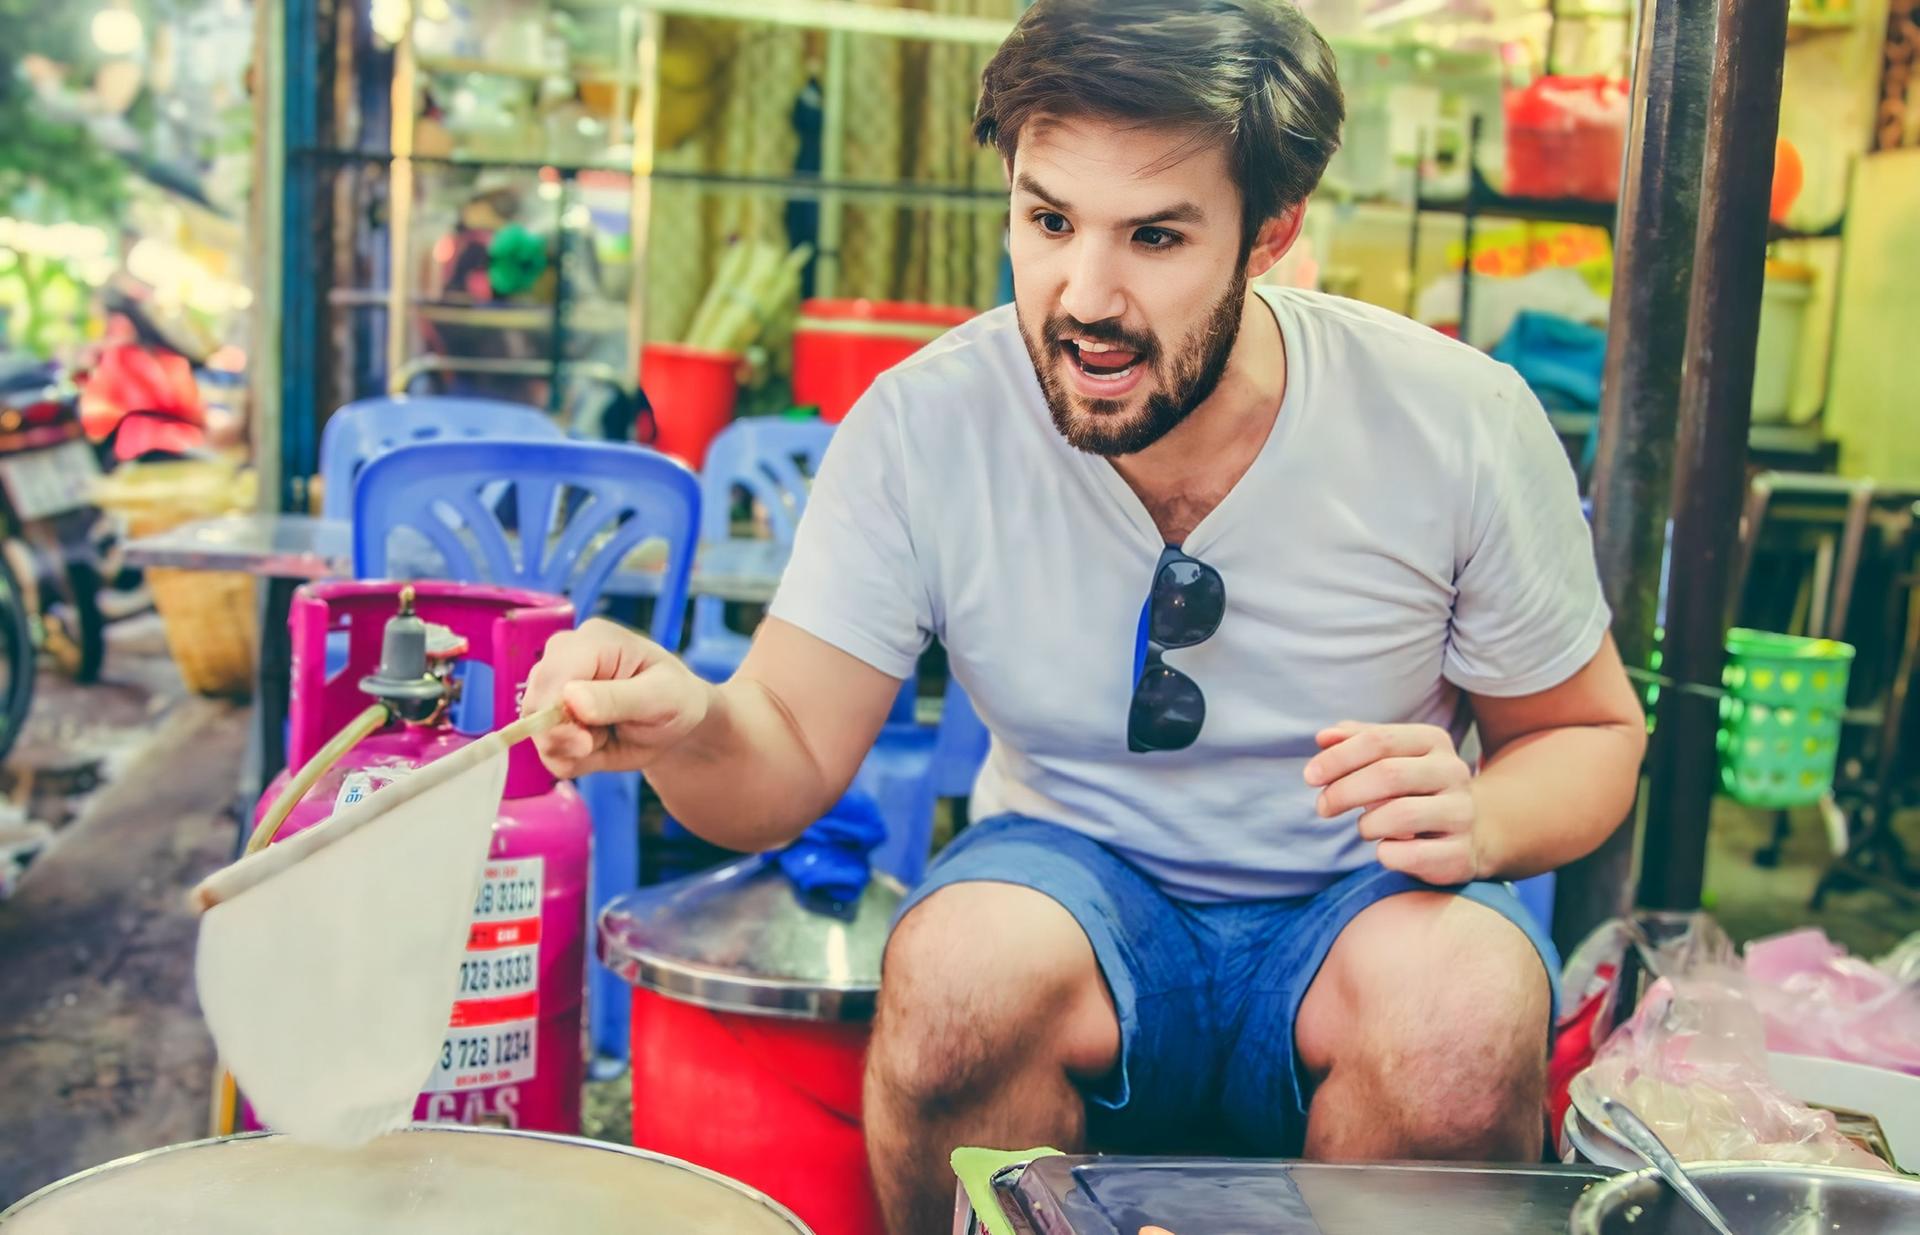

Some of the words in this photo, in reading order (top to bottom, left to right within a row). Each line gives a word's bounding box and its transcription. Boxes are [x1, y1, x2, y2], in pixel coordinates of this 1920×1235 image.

[459, 959, 491, 992] 728
[494, 954, 532, 988] 3333
[458, 1036, 489, 1068] 728
[495, 1030, 530, 1064] 1234
[427, 1085, 520, 1129] GAS
